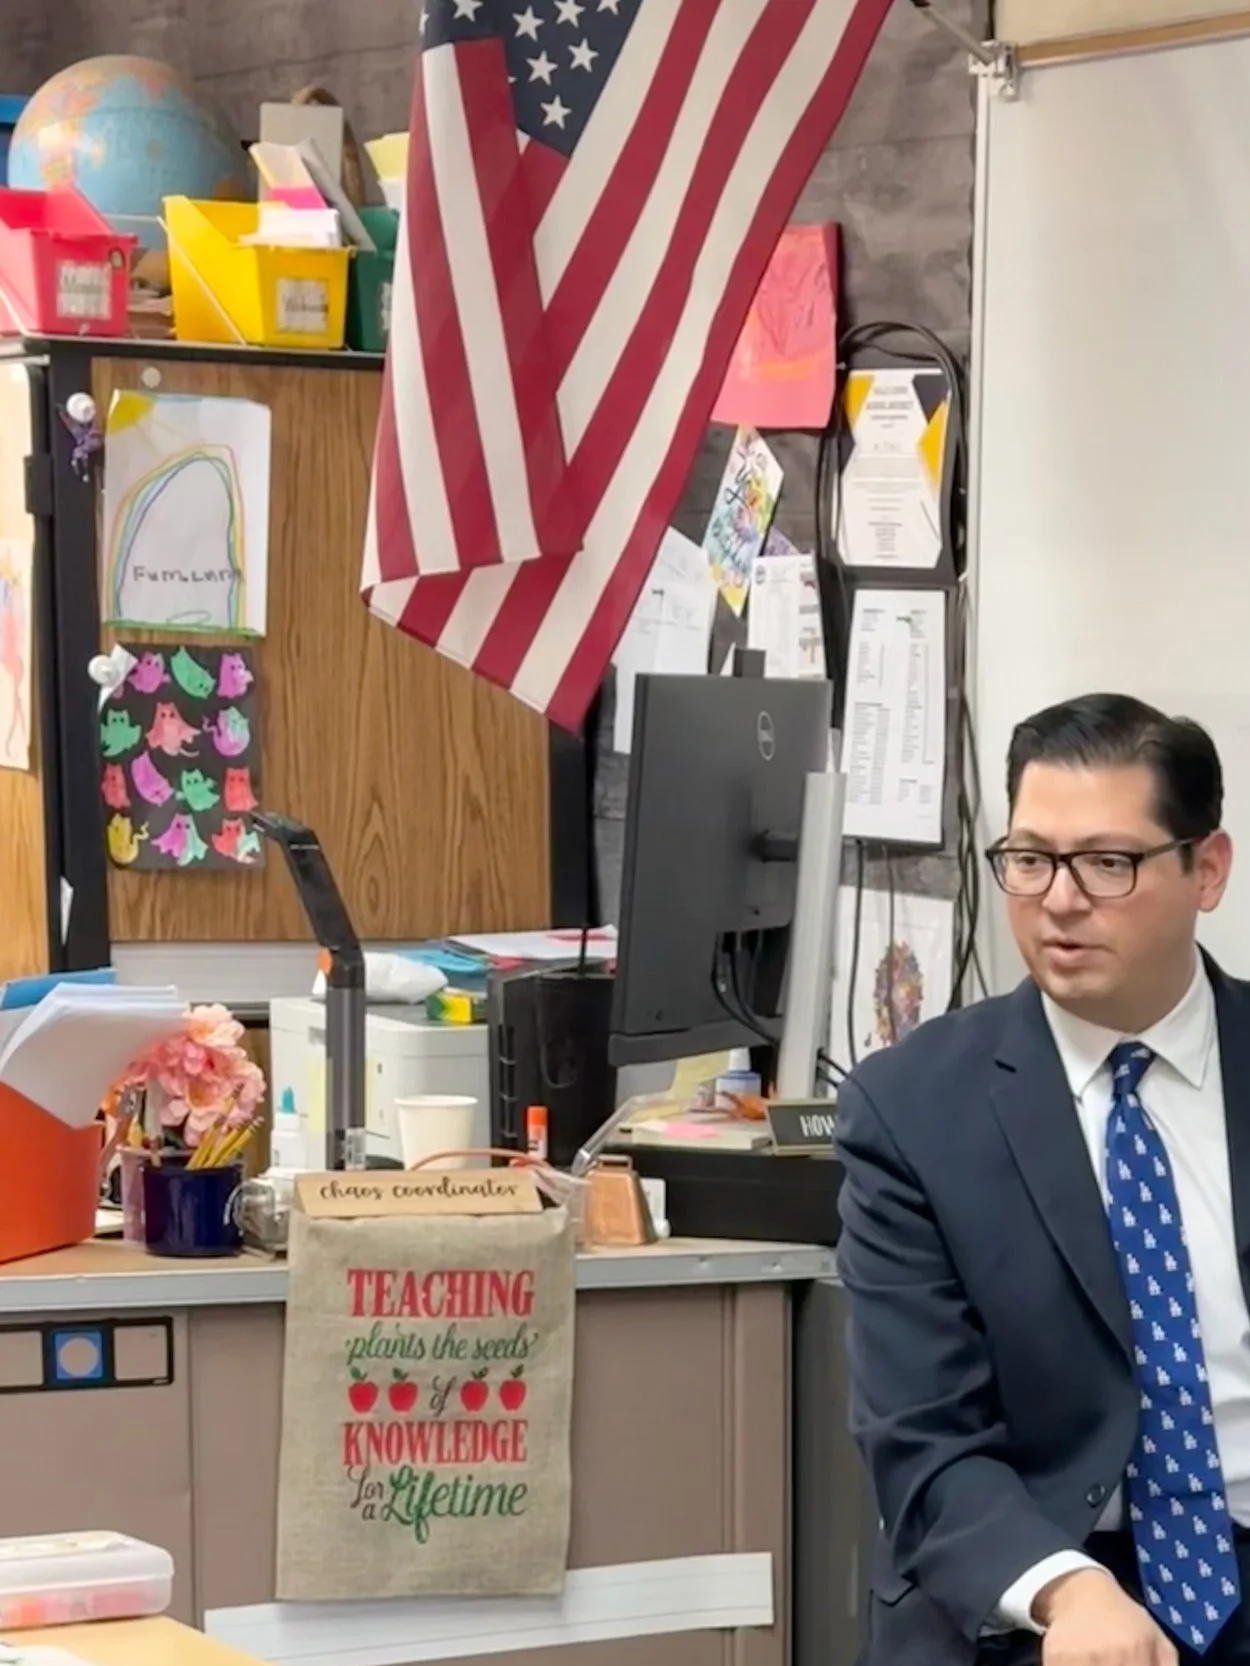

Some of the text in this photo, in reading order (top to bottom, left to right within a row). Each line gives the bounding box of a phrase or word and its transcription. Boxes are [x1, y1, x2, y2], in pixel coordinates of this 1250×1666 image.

[320, 1176, 518, 1200] chaos coordinator
[346, 1268, 536, 1318] TEACHING
[345, 1321, 533, 1365] plants the seeds
[429, 1375, 457, 1418] of
[342, 1419, 529, 1466] KNOWLEDGE
[347, 1456, 528, 1544] for a Lifetime
